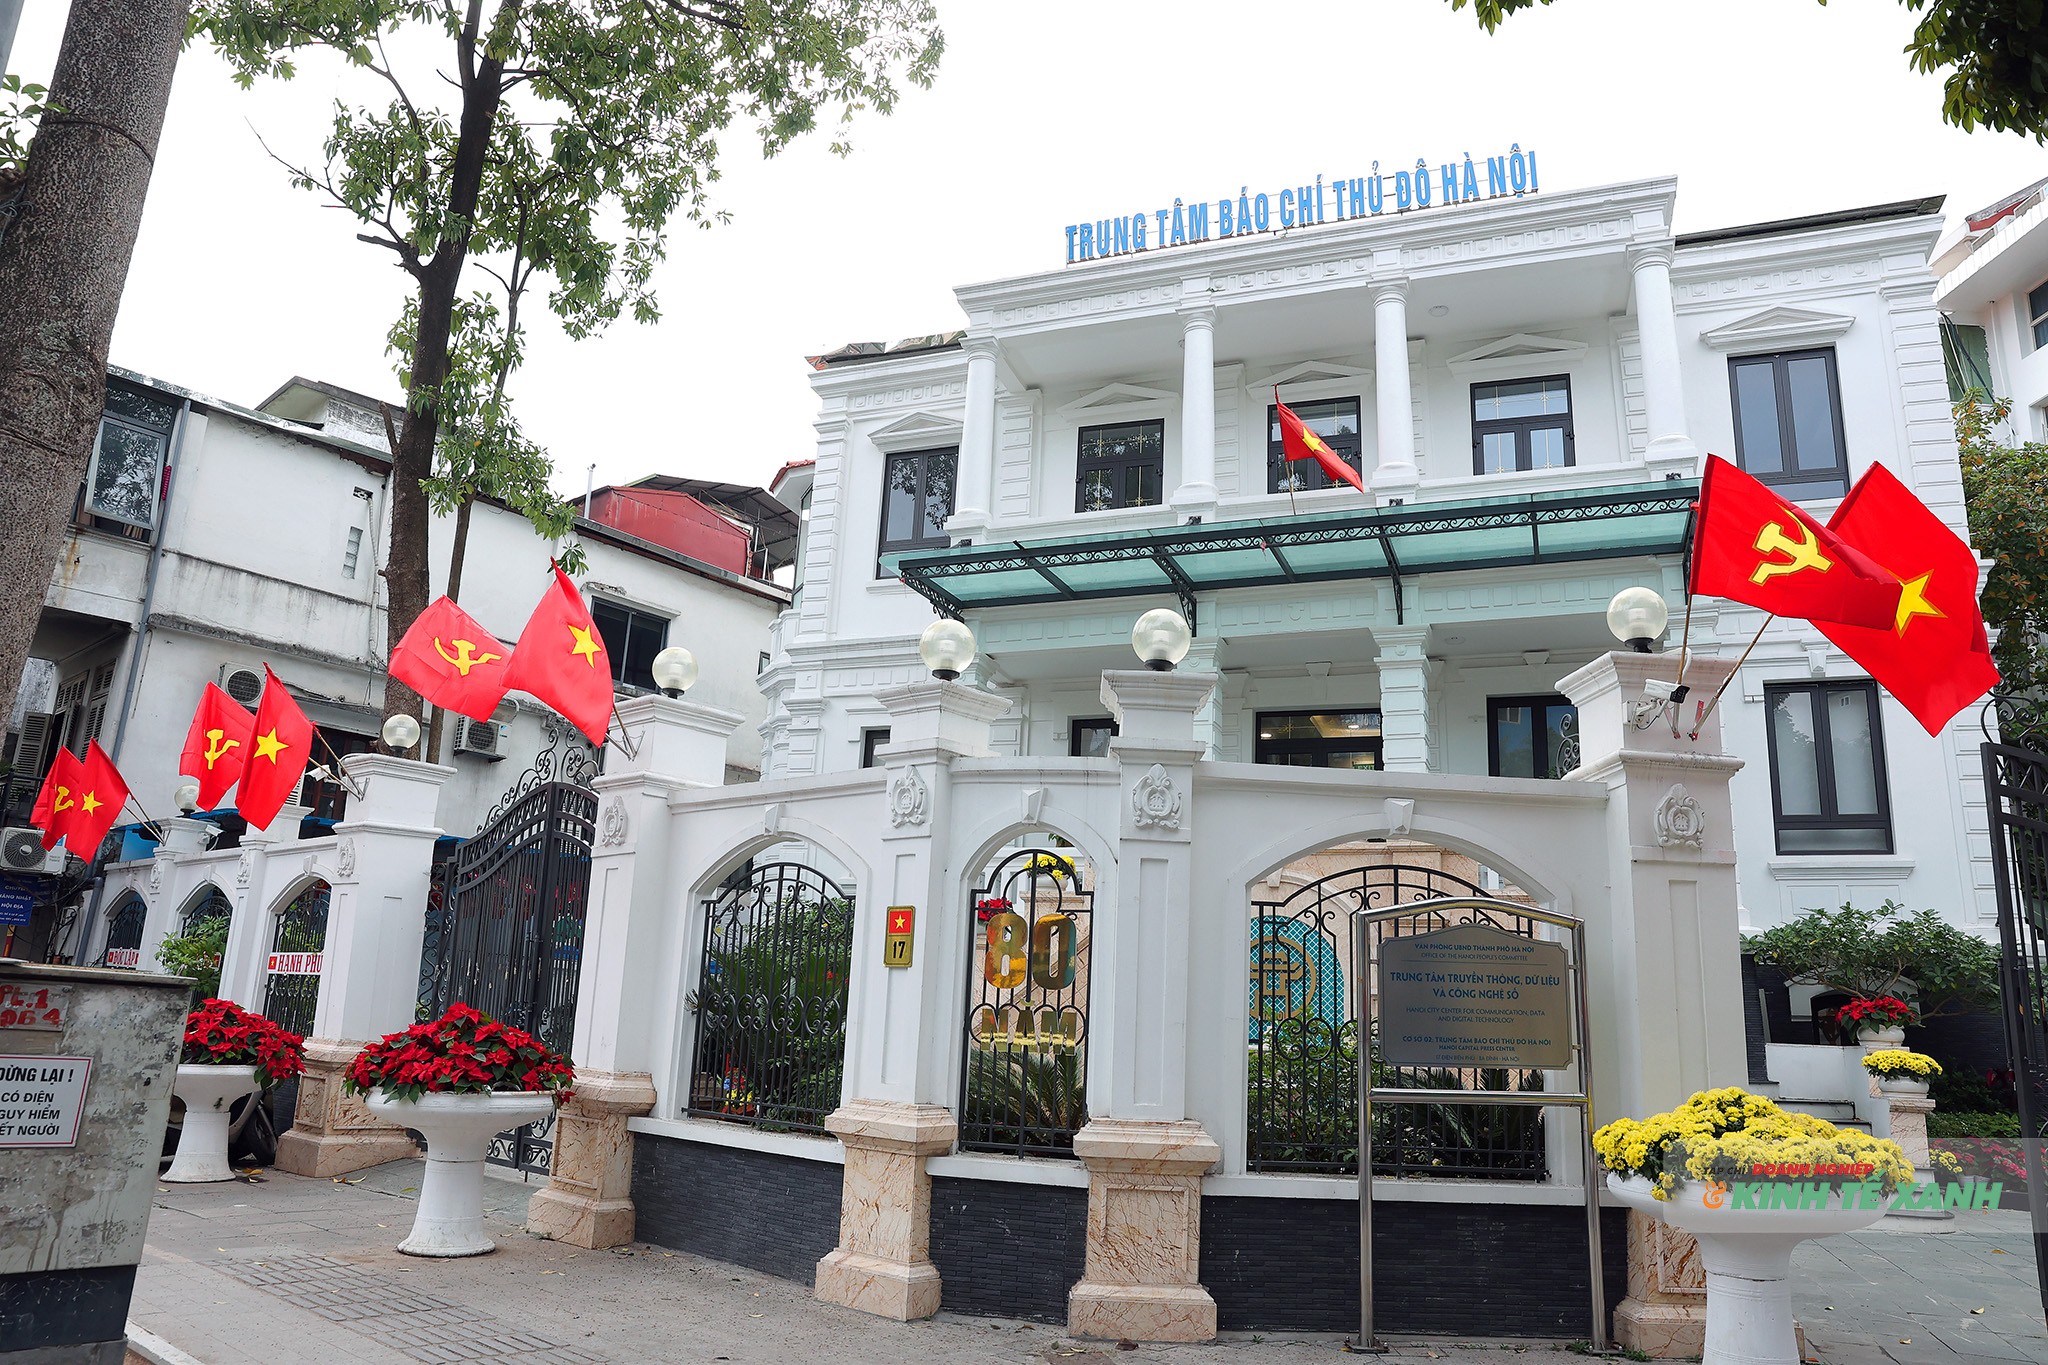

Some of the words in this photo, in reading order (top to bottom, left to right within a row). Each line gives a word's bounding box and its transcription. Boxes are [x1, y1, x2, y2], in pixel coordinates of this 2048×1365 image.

[1065, 212, 1147, 262] TRUNG
[1156, 198, 1208, 247] TÂM
[1218, 186, 1270, 237] BÁO
[1279, 174, 1323, 229] CHÍ
[1333, 160, 1384, 221] THỦ
[1395, 158, 1431, 210] ĐÔ
[1441, 152, 1480, 205] HÀ
[1487, 143, 1538, 198] NỘI
[893, 941, 905, 958] 17
[985, 912, 1077, 990] 80
[1390, 972, 1422, 982] TRUNG
[1425, 971, 1445, 982] TÂM
[1448, 971, 1483, 983] TRUYỀN
[1486, 973, 1523, 985] THÔNG,
[1525, 974, 1539, 985] DỮ
[1541, 974, 1560, 987] LIỆU
[1433, 986, 1446, 998] VÀ
[1448, 986, 1476, 998] CÔNG
[1479, 988, 1504, 1000] NGHỆ
[1507, 987, 1519, 999] SỐ
[1475, 1016, 1514, 1024] TECHNOLOGY
[41, 1068, 64, 1085] LẠI
[68, 1069, 74, 1082] !
[1, 1090, 20, 1102] CÓ
[23, 1090, 54, 1105] ĐIỆN
[28, 1104, 60, 1120] HIỂM
[17, 1123, 60, 1136] NGƯỜI
